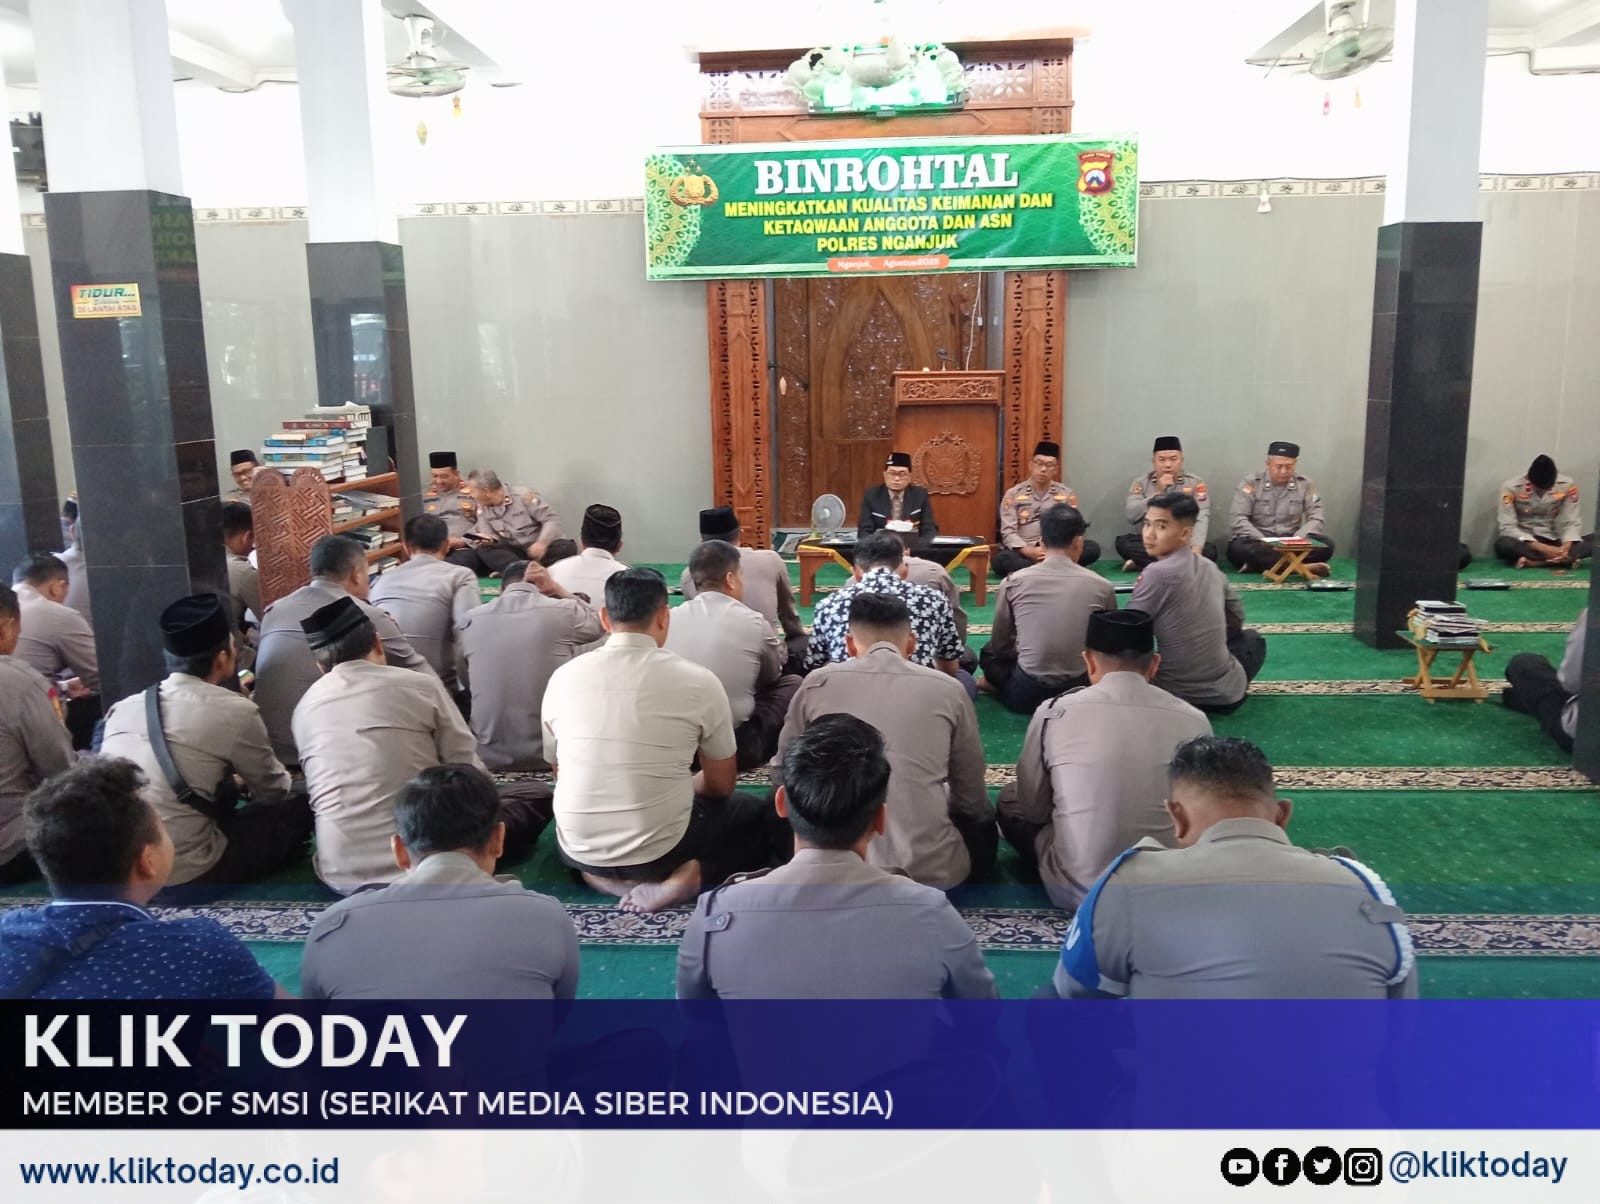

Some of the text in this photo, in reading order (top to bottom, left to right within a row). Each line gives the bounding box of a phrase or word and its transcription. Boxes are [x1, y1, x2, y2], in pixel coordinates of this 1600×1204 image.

[753, 153, 1019, 194] BINROHTAL
[725, 192, 1053, 217] MENINGKATKAN KUALITAS KEIMANAN DAN
[764, 213, 1012, 235] KETAQWAAN ANGGOTA DAN ASN
[817, 234, 958, 252] POLRES NGANJUK
